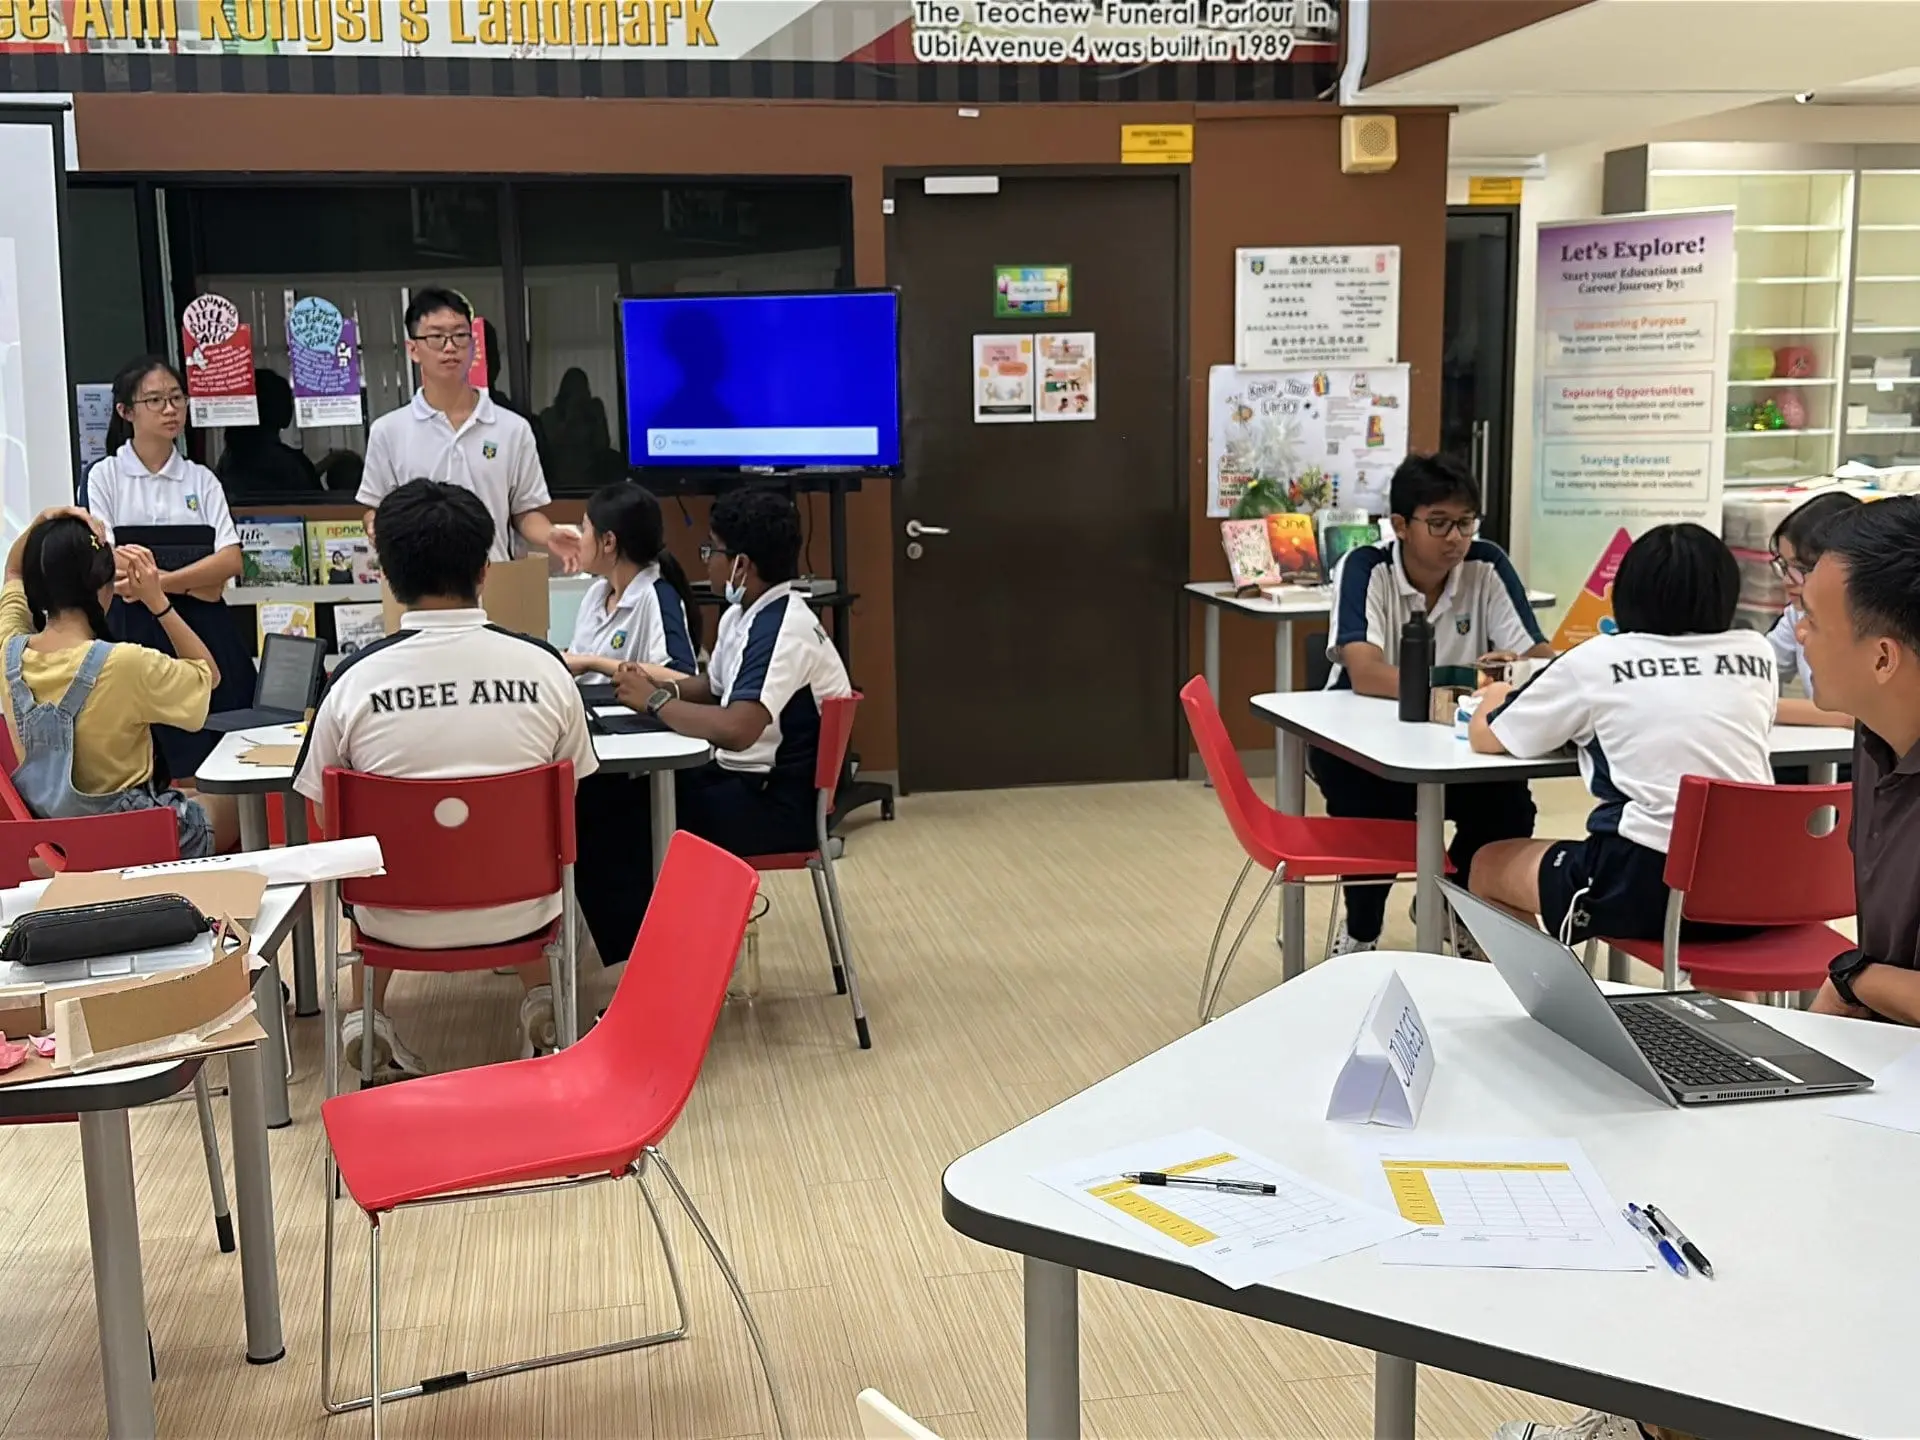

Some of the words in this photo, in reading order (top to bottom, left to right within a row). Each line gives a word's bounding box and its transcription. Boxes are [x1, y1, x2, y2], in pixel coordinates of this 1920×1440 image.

[72, 0, 179, 39] Ann
[451, 0, 719, 46] Landmark
[916, 0, 960, 23] The
[976, 1, 1091, 24] Teochew
[1106, 3, 1195, 24] Funeral
[1211, 3, 1293, 24] Parlour
[1307, 3, 1327, 23] in
[918, 35, 958, 57] Ubi
[966, 35, 1064, 57] Avenue
[1071, 35, 1086, 57] 4
[1094, 40, 1142, 57] was
[1150, 35, 1200, 57] built
[1207, 35, 1229, 56] in
[1238, 35, 1291, 56] 1989
[1561, 240, 1608, 262] Let's
[1614, 236, 1706, 262] Explore!
[1561, 269, 1590, 282] Start
[1590, 268, 1617, 283] your
[1620, 266, 1678, 278] Education
[1680, 263, 1703, 275] and
[1578, 281, 1616, 294] Career
[1619, 280, 1664, 295] Journey
[196, 309, 222, 324] FEEL
[1562, 387, 1613, 400] Exploring
[1616, 384, 1694, 398] Opportunities
[1580, 454, 1620, 467] Staying
[1622, 454, 1671, 465] Relevant
[1610, 655, 1703, 684] NGEE
[1714, 654, 1773, 683] ANN
[369, 681, 459, 713] NGEE
[469, 679, 540, 705] ANN
[1389, 1005, 1424, 1088] JUDGES
